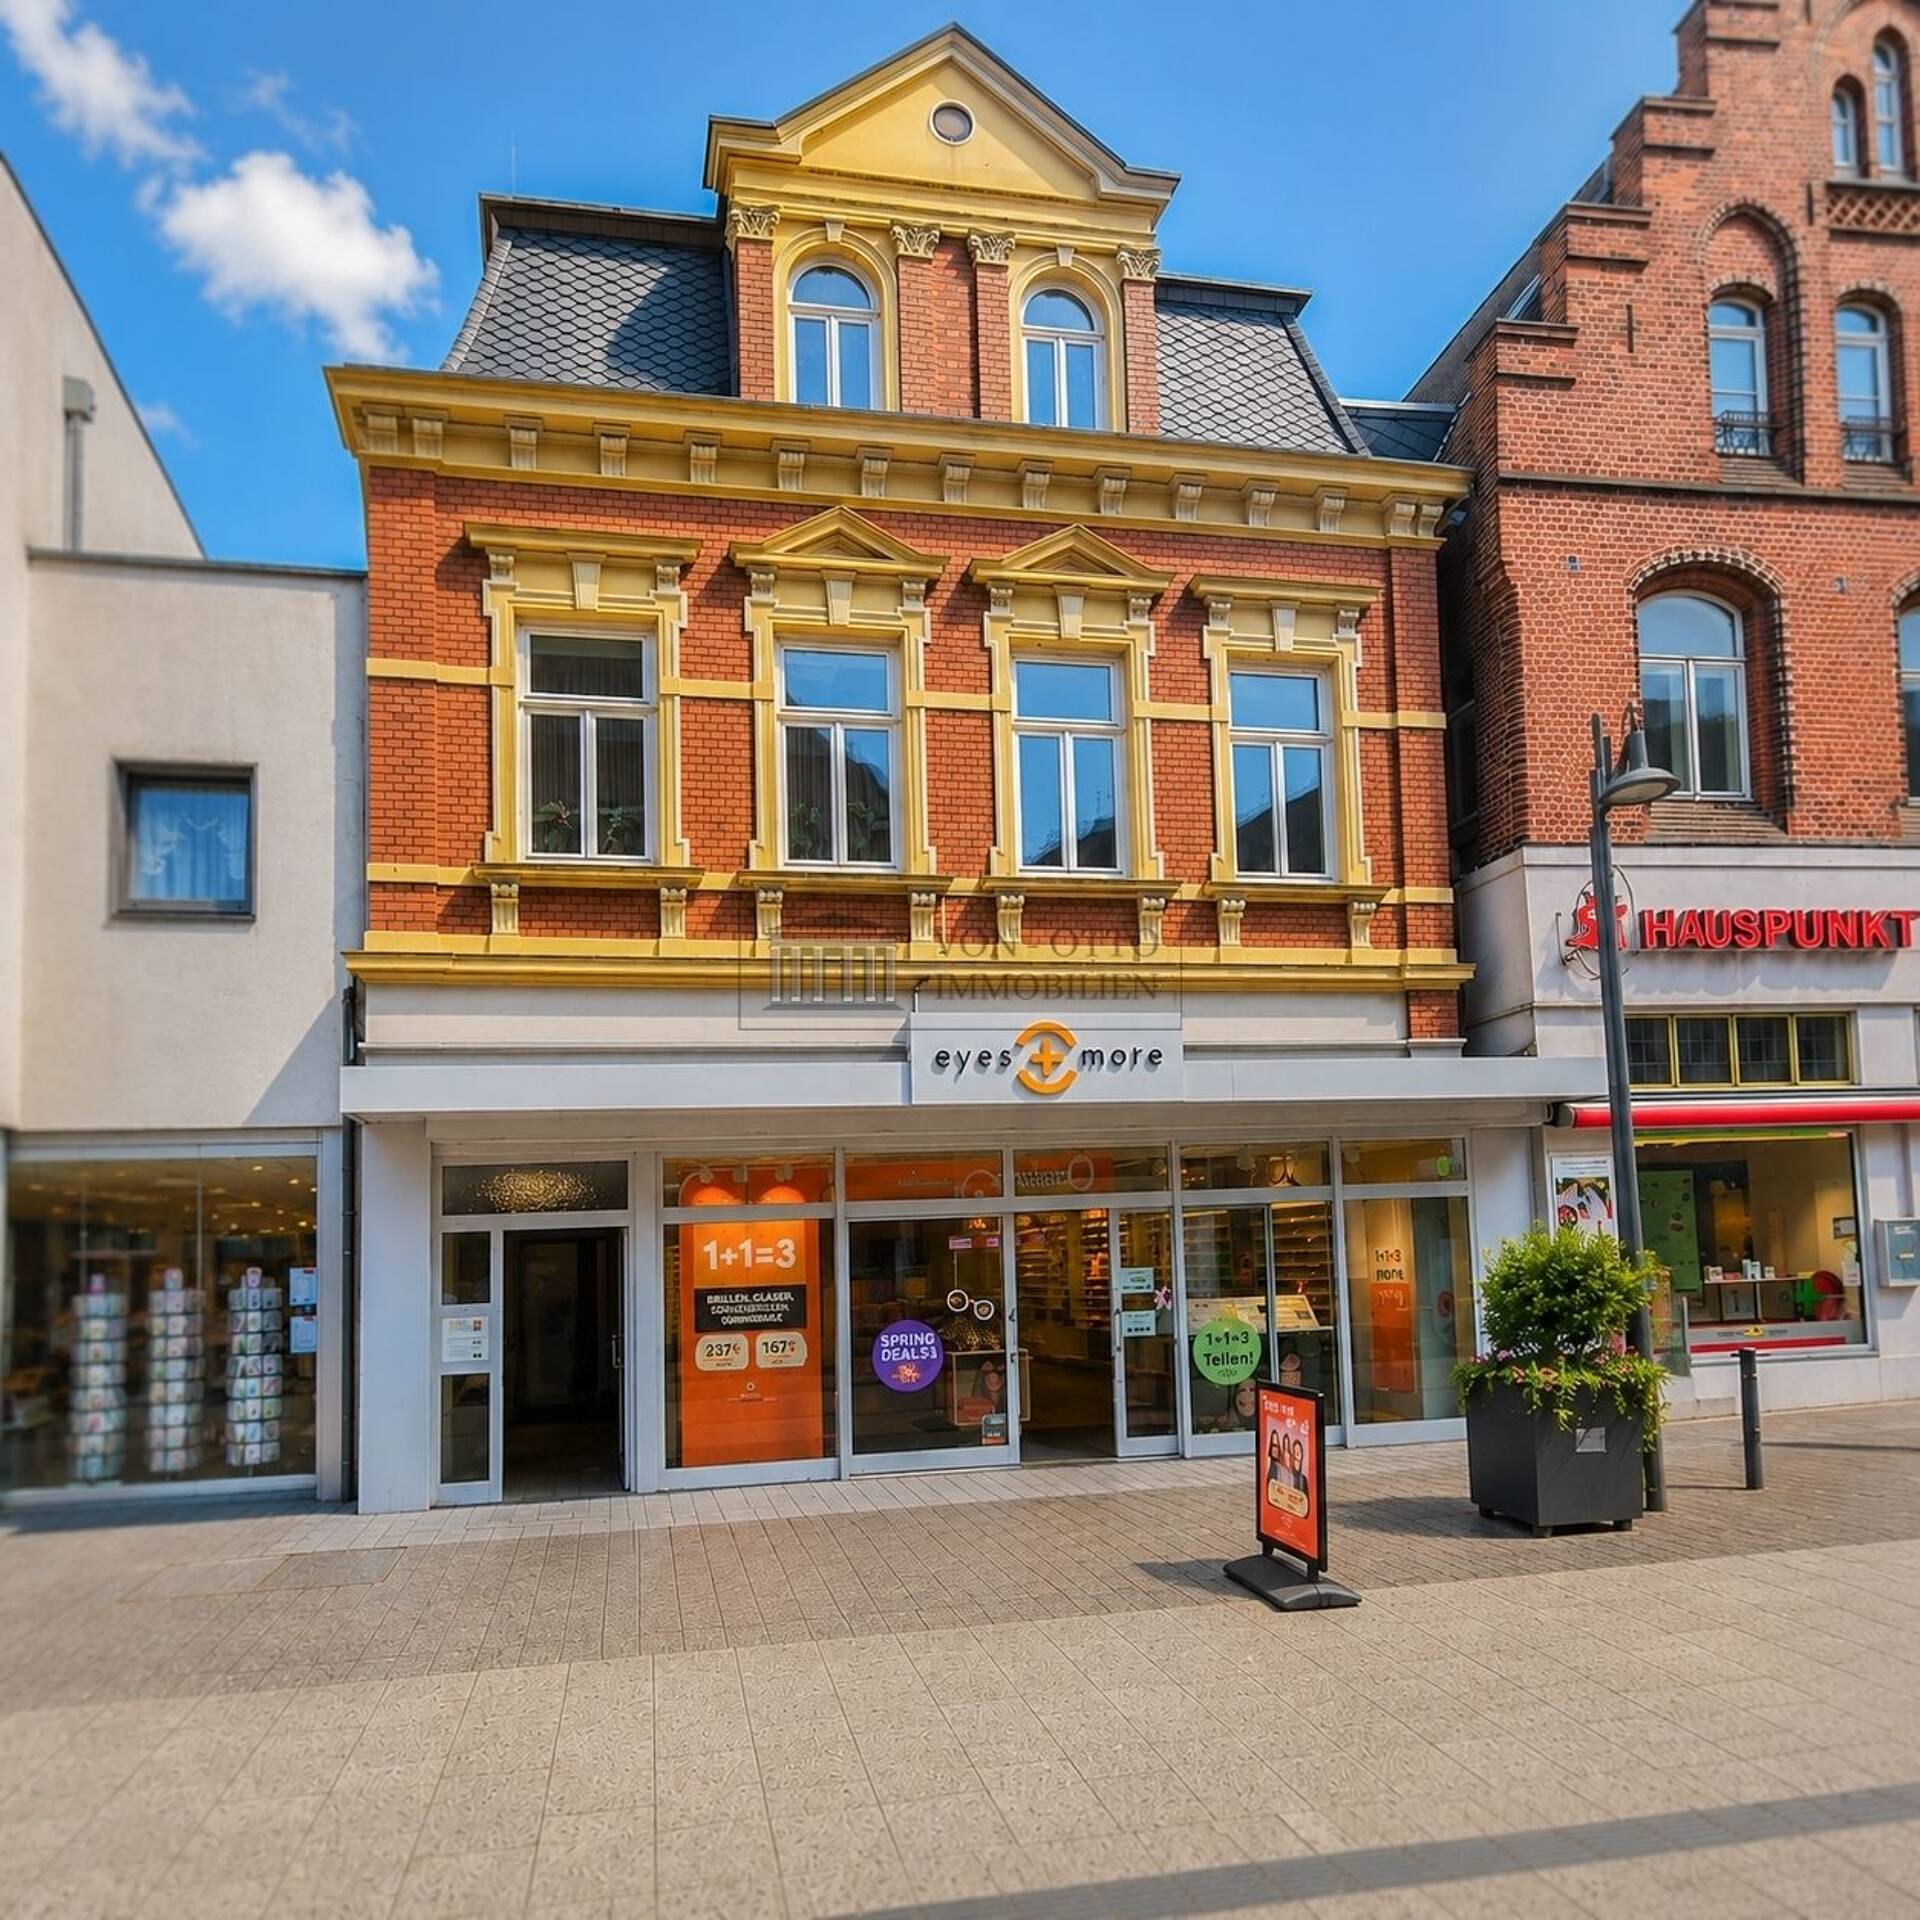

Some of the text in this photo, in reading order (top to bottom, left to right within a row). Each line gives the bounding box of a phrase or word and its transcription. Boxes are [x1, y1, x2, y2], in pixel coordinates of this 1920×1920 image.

[1639, 908, 1920, 949] HAUSPUNKT
[935, 1049, 1012, 1075] eyes
[1081, 1047, 1163, 1067] more
[703, 1237, 797, 1270] 1+1=3
